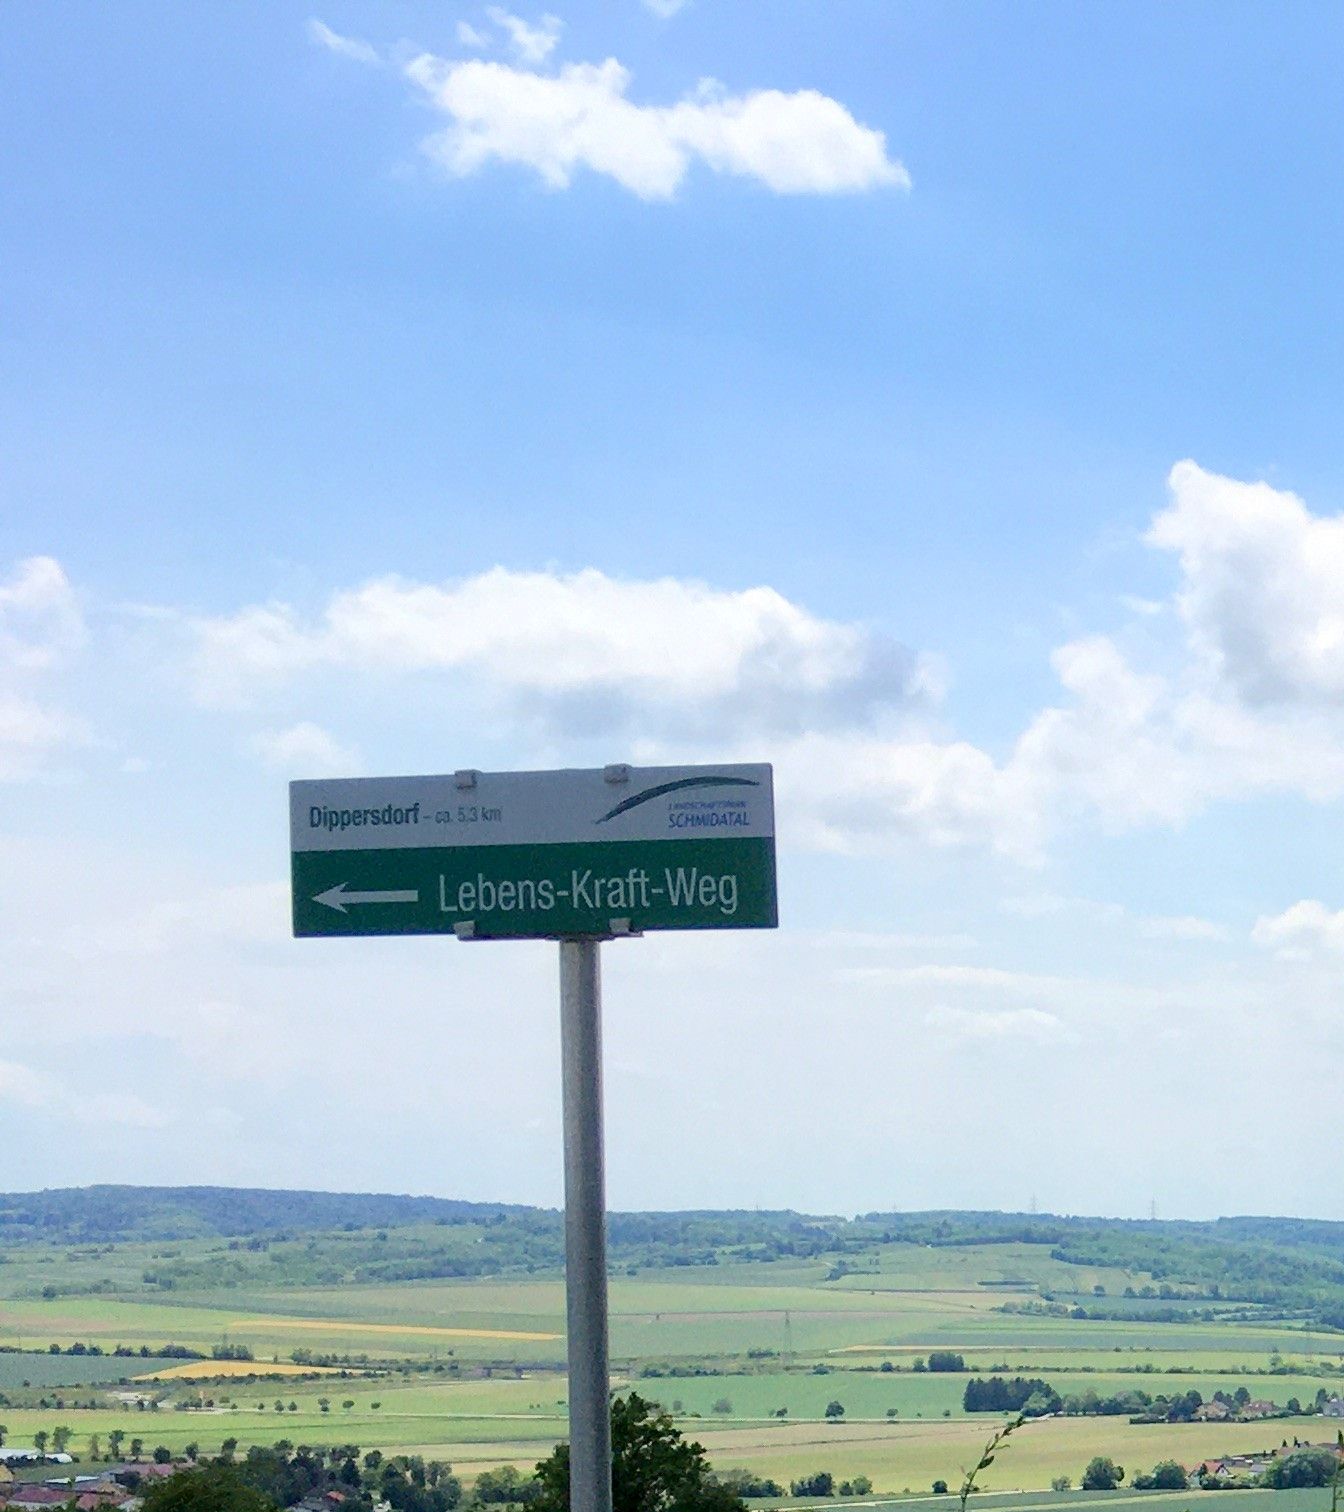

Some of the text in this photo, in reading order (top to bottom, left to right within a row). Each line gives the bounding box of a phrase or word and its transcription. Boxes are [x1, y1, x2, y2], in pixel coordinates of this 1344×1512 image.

[309, 802, 420, 832] Dippersdorf
[481, 805, 503, 822] km
[668, 811, 750, 828] SCHMIDATAL
[438, 866, 738, 915] Lebens-Kraft-Weg
